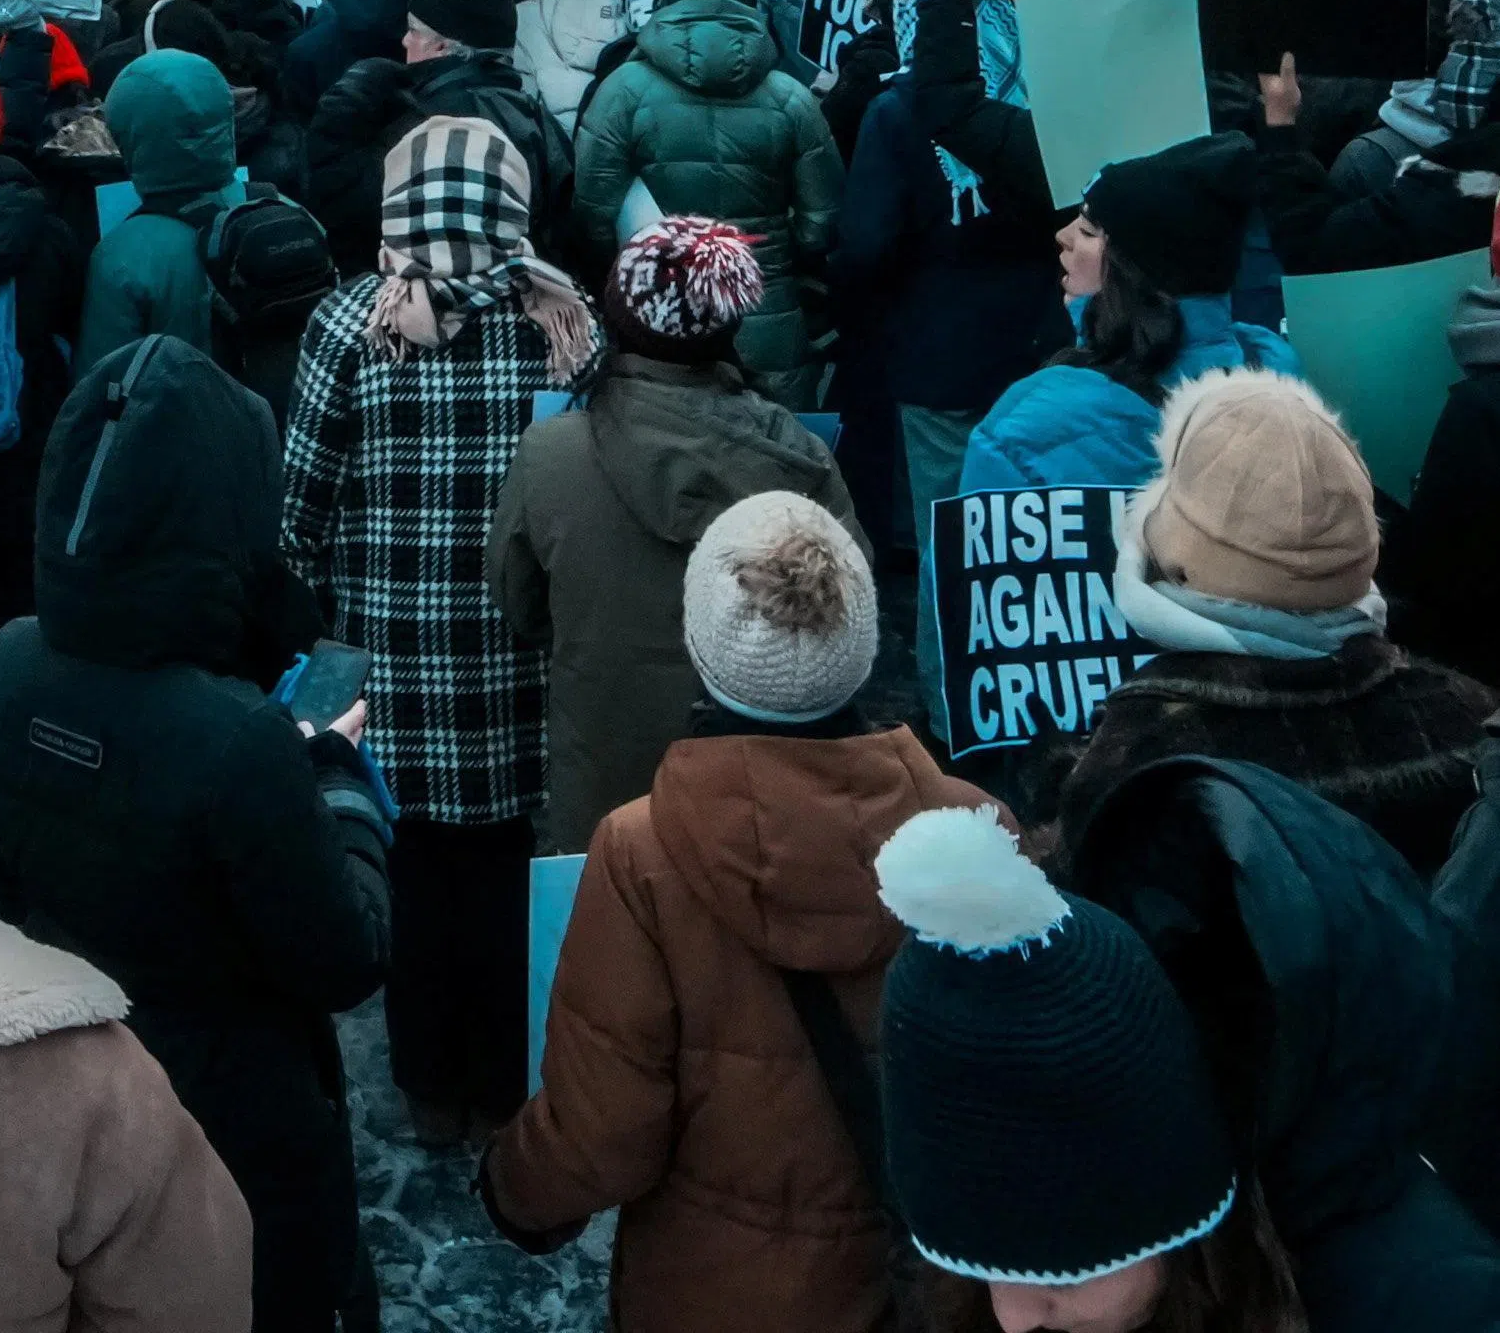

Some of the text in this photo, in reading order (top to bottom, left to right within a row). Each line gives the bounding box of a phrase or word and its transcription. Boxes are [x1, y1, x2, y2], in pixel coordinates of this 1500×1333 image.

[820, 21, 853, 74] IC
[963, 489, 1088, 569] RISE
[968, 570, 1128, 655] AGAIN
[969, 653, 1140, 741] CRUE
